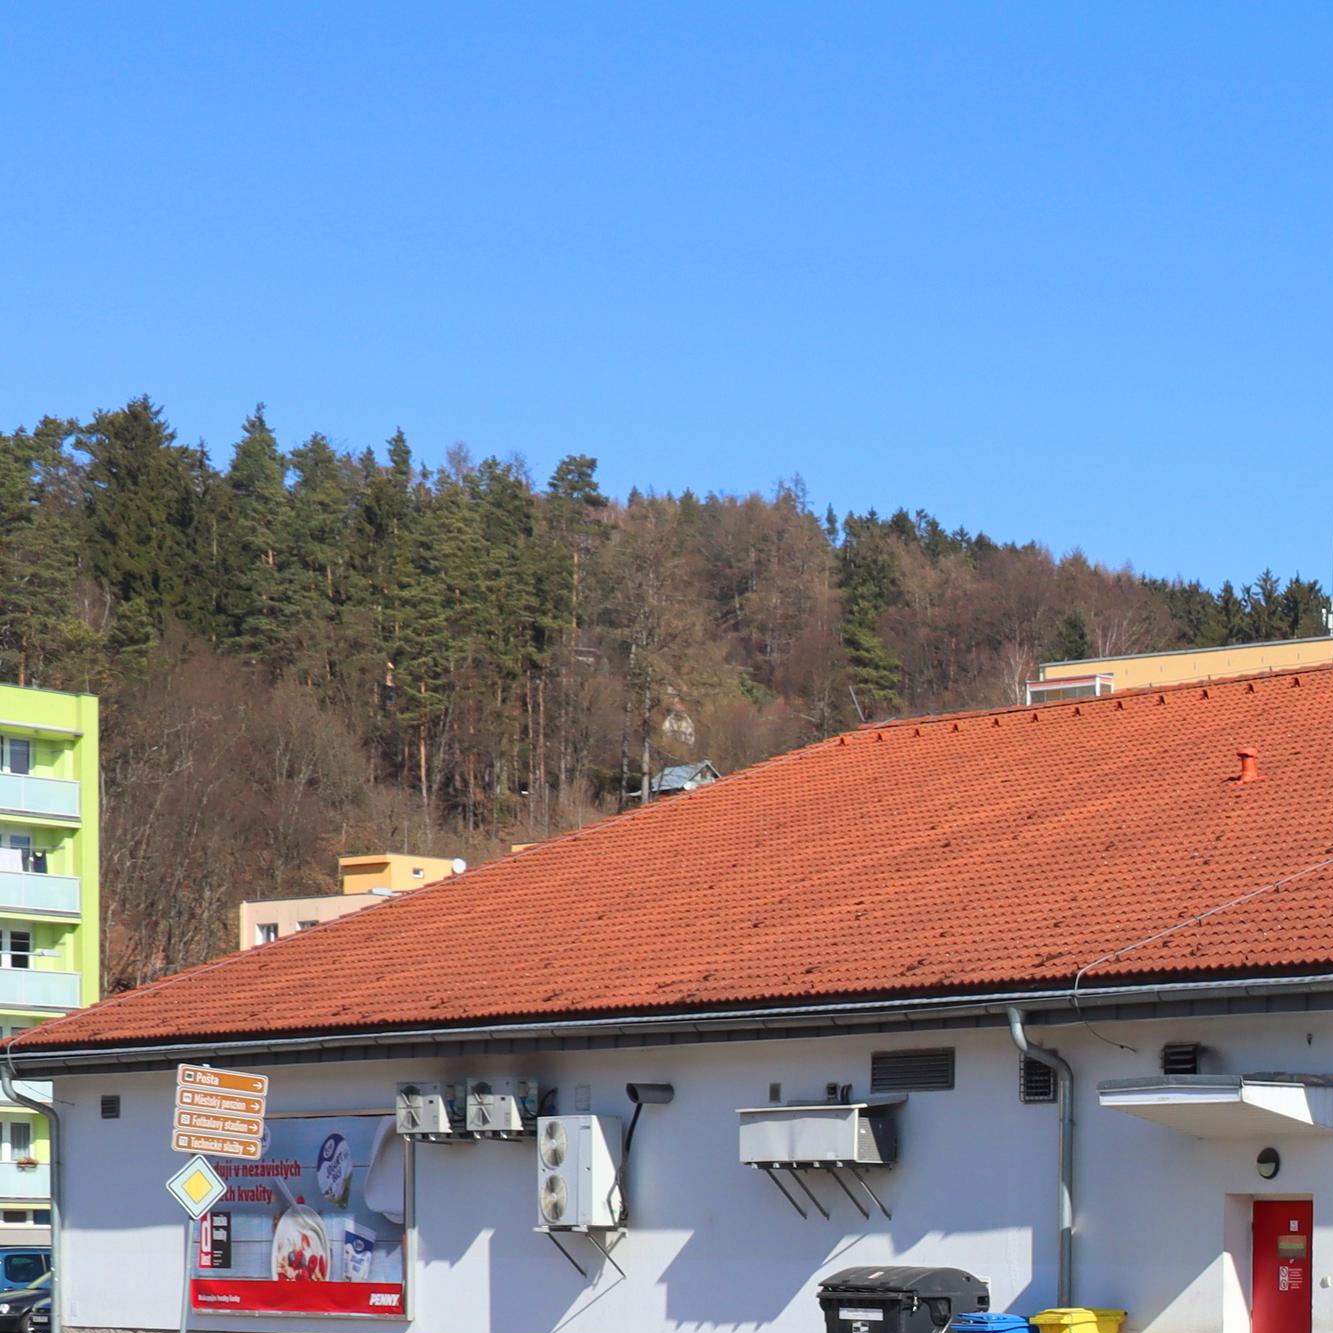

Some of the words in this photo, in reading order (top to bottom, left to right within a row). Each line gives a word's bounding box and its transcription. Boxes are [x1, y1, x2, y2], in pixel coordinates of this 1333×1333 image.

[196, 1072, 219, 1085] Pošta
[234, 1164, 239, 1176] v
[242, 1159, 300, 1179] nezávislých
[237, 1184, 272, 1204] kvality
